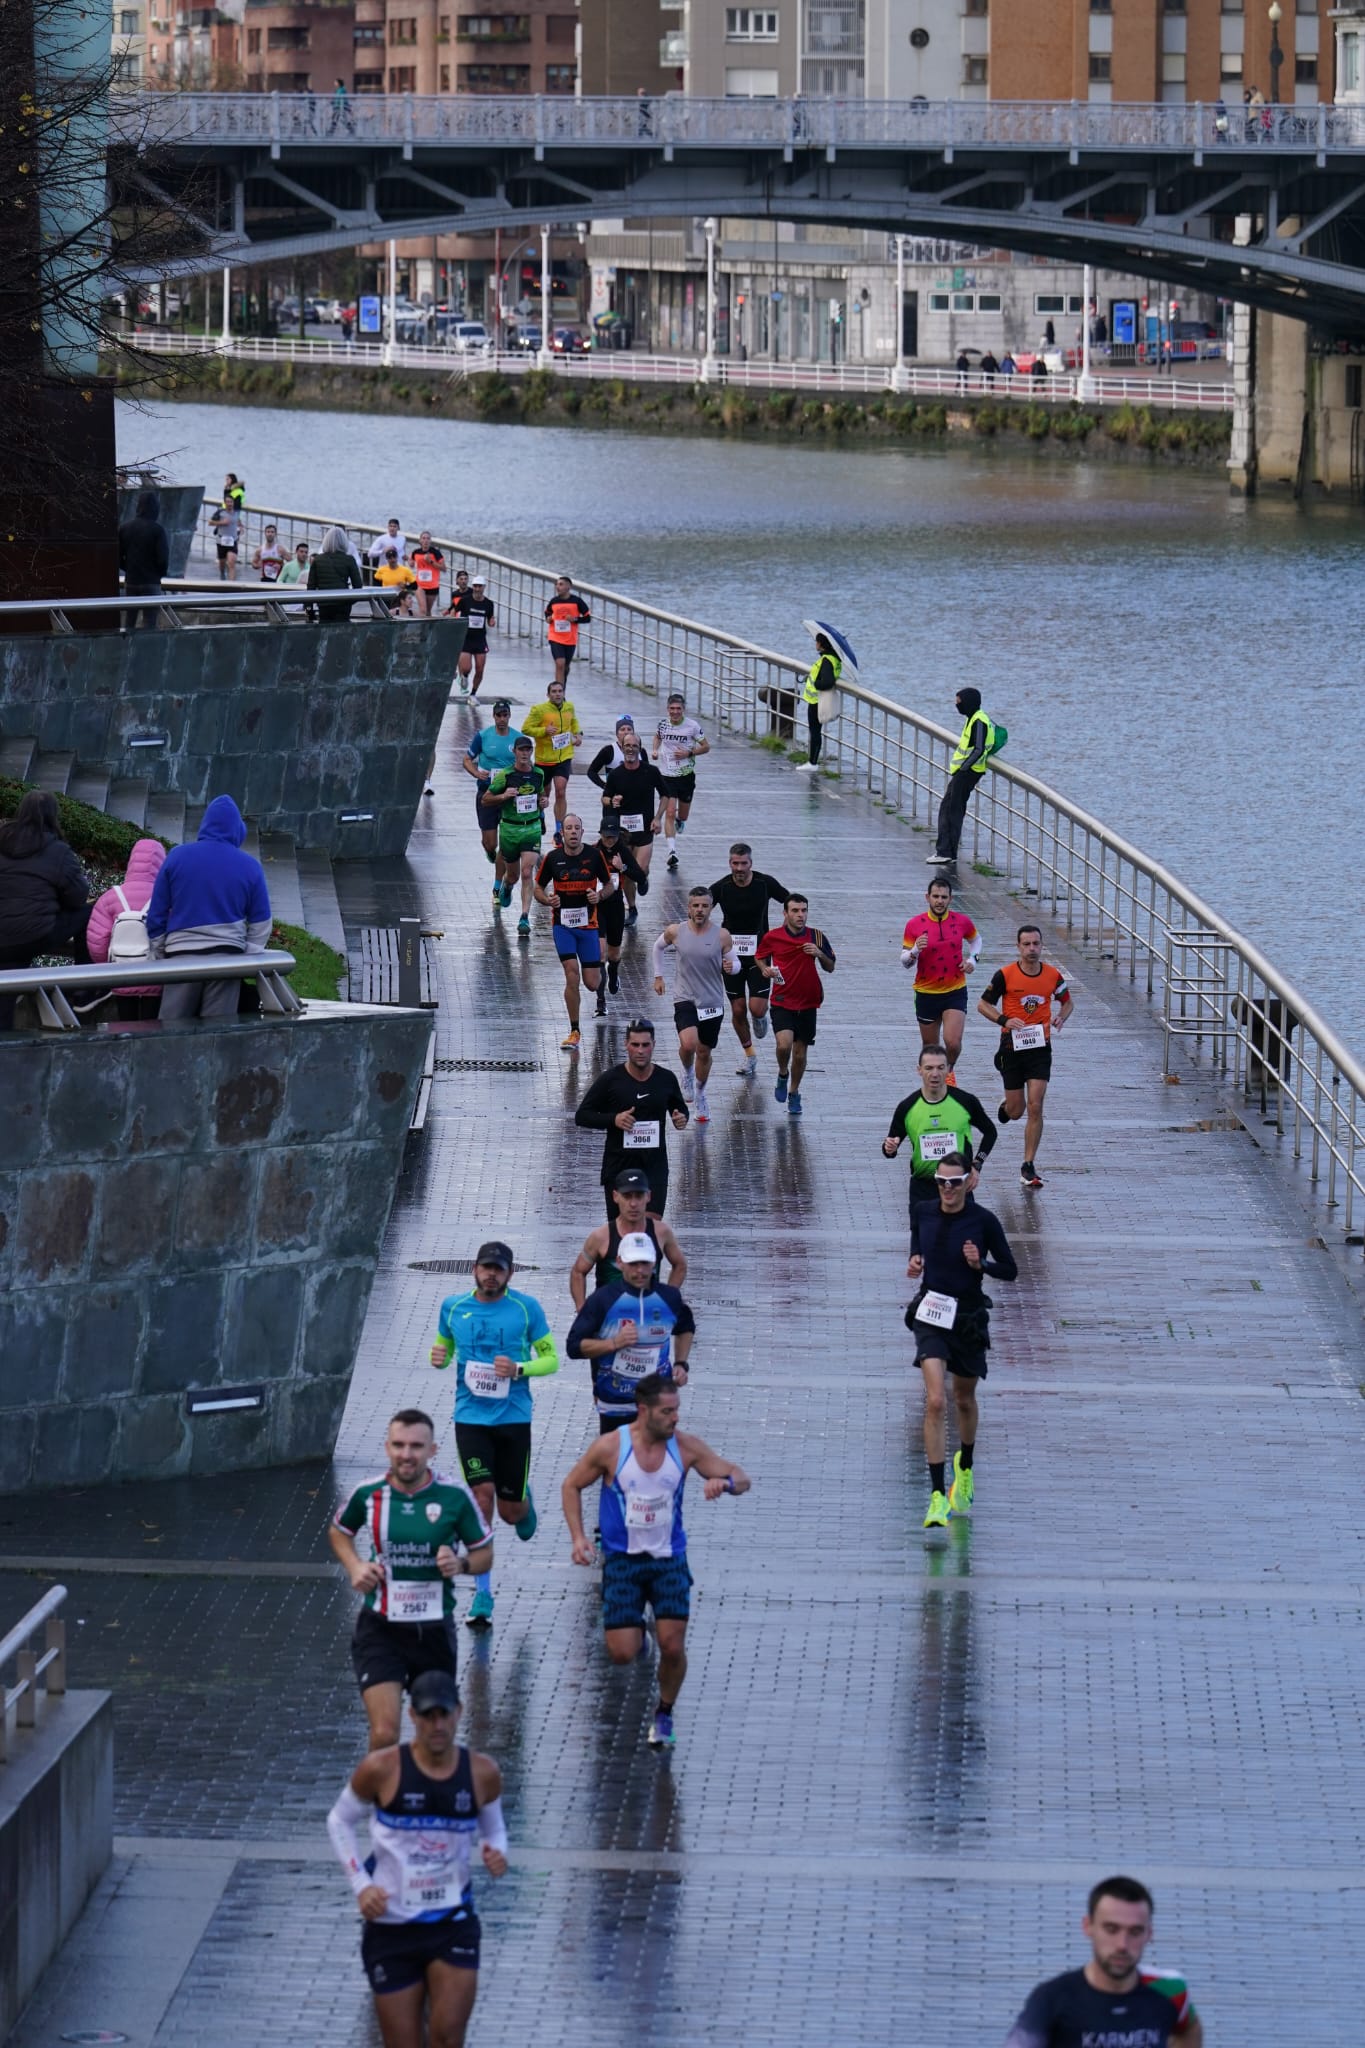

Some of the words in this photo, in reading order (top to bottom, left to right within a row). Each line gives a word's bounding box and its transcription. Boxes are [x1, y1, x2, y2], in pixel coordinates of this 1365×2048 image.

[633, 1135, 651, 1144] 3068
[933, 1147, 946, 1155] 458
[475, 1380, 498, 1391] 2068
